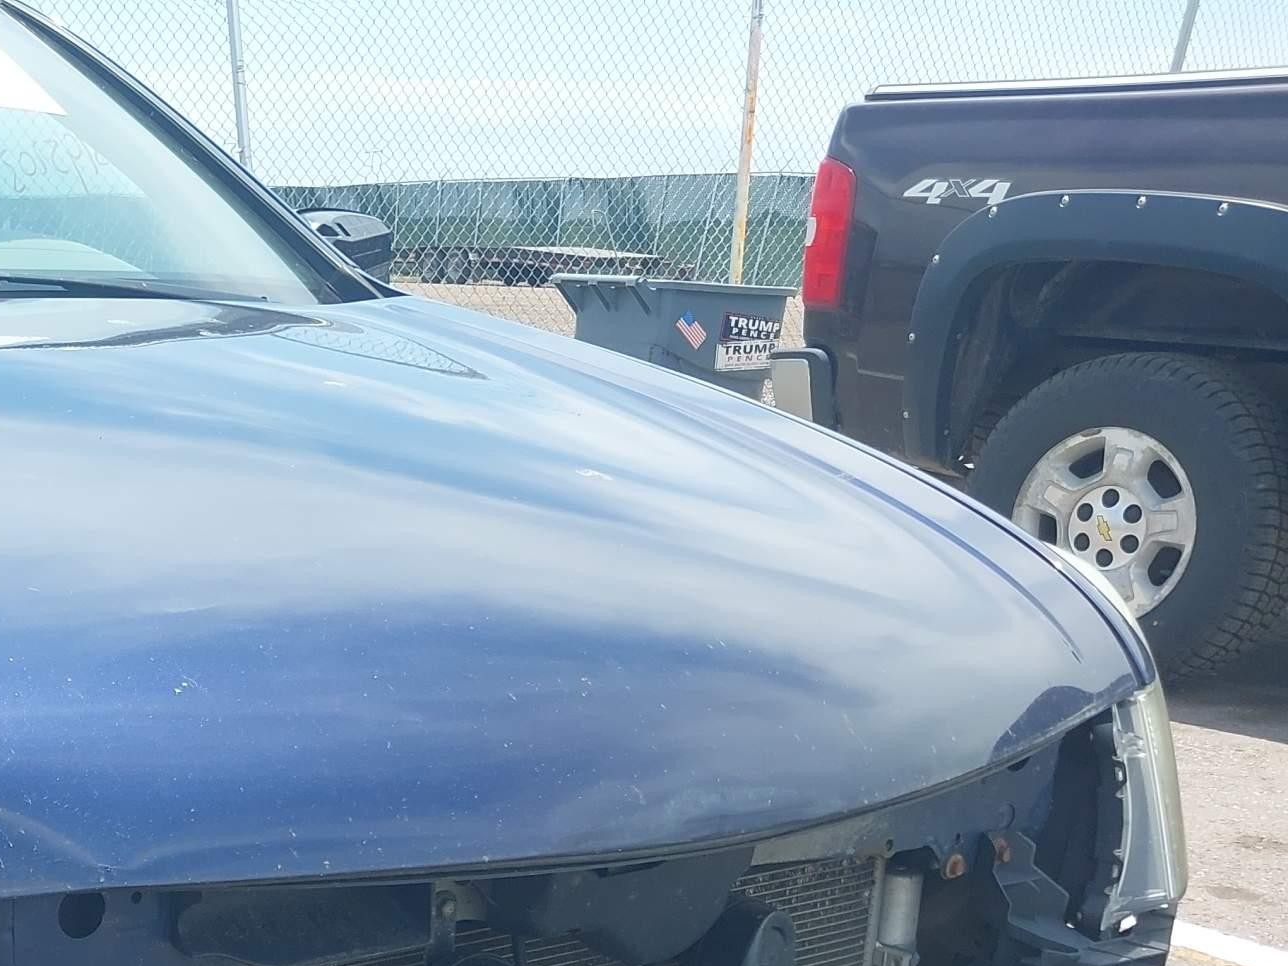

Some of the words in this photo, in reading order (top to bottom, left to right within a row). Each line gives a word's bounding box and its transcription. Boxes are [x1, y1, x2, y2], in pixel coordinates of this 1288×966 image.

[729, 316, 780, 333] TRUMP
[732, 327, 775, 340] PENCE
[724, 343, 776, 355] TRUMP
